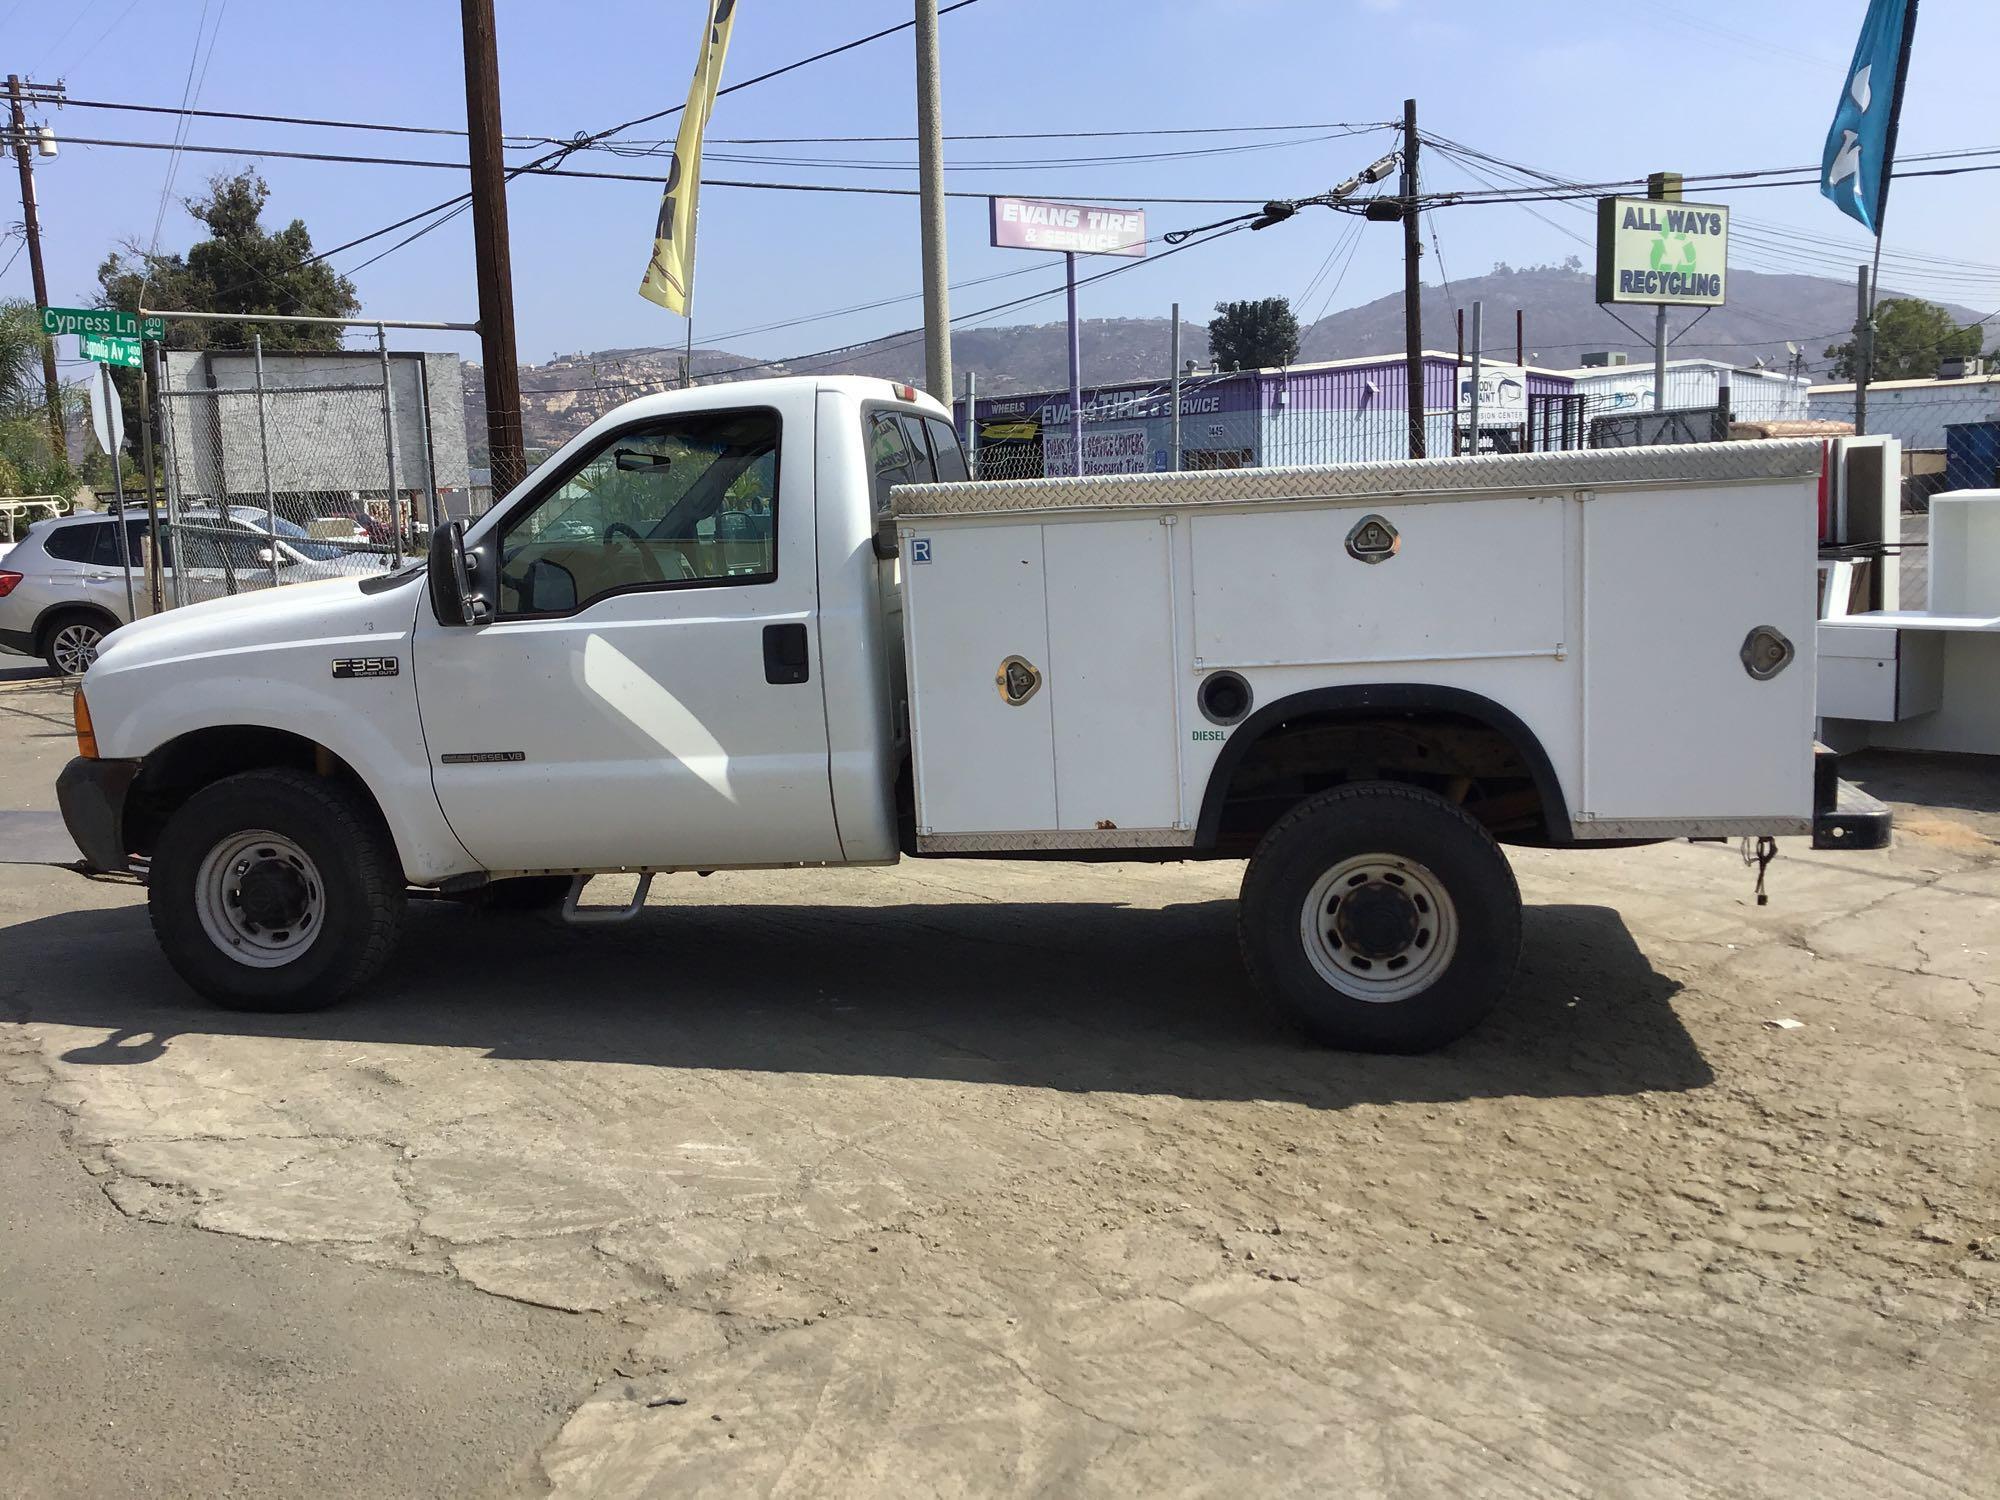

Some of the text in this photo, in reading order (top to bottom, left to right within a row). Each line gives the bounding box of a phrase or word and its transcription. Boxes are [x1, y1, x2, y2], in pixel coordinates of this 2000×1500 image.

[1002, 203, 1139, 232] EVANS TIRE
[1622, 206, 1721, 236] ALL WAYS
[1025, 228, 1119, 249] & SERVICE
[1620, 269, 1721, 296] RECYCLING
[45, 310, 161, 334] Cypress Ln 100
[80, 335, 109, 360] Magnolia
[111, 342, 124, 360] Av
[992, 402, 1025, 414] WHEELS
[1042, 403, 1097, 425] EVAS
[1099, 390, 1149, 419] TIRE
[1163, 397, 1220, 416] SRVICE
[1498, 411, 1523, 419] CENTER
[1084, 460, 1123, 475] Discount
[1126, 458, 1144, 473] Tire
[913, 541, 929, 560] R
[1192, 730, 1226, 741] DIESEL
